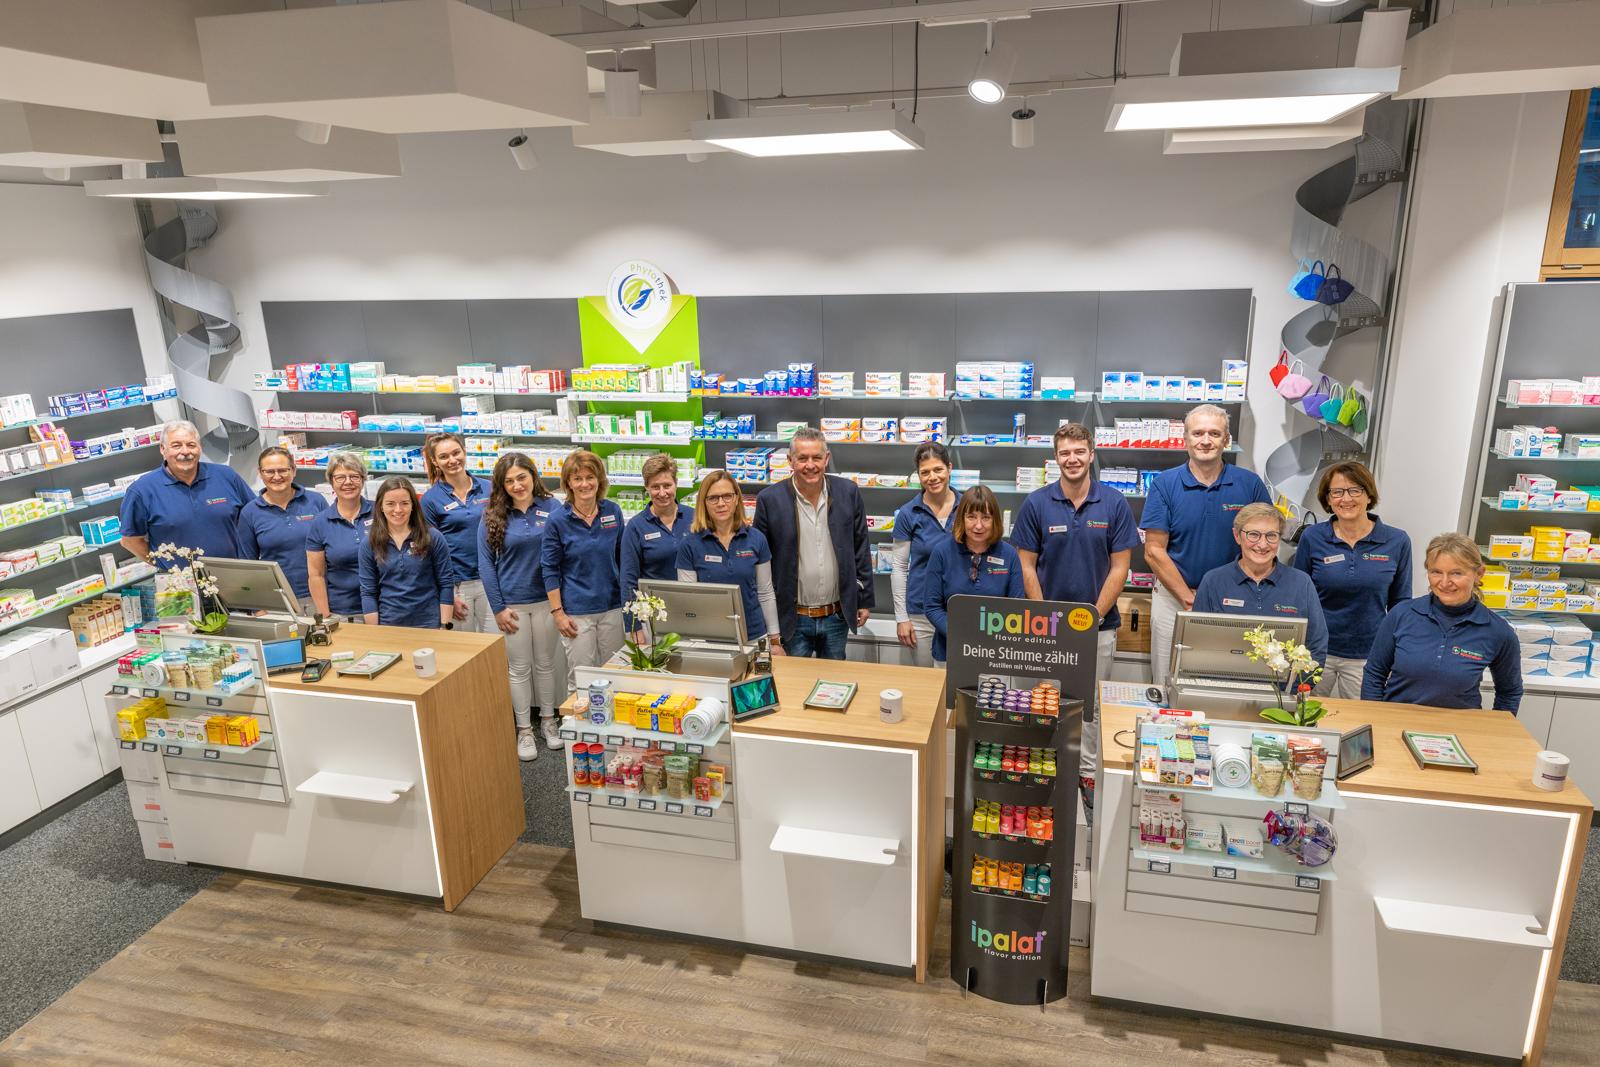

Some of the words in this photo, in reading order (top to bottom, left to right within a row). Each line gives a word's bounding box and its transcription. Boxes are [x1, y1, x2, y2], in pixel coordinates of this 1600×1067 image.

[980, 606, 1059, 636] ipalat
[1074, 612, 1088, 620] Jetzt
[994, 634, 1022, 643] flavor
[1024, 637, 1057, 645] edition
[963, 644, 996, 659] Deine
[998, 646, 1042, 663] Stimme
[1044, 651, 1079, 666] zählt!
[988, 662, 1013, 670] Pastillen
[1024, 665, 1046, 673] Vitamin
[971, 919, 1044, 954] ipalat
[984, 948, 1009, 959] flavor
